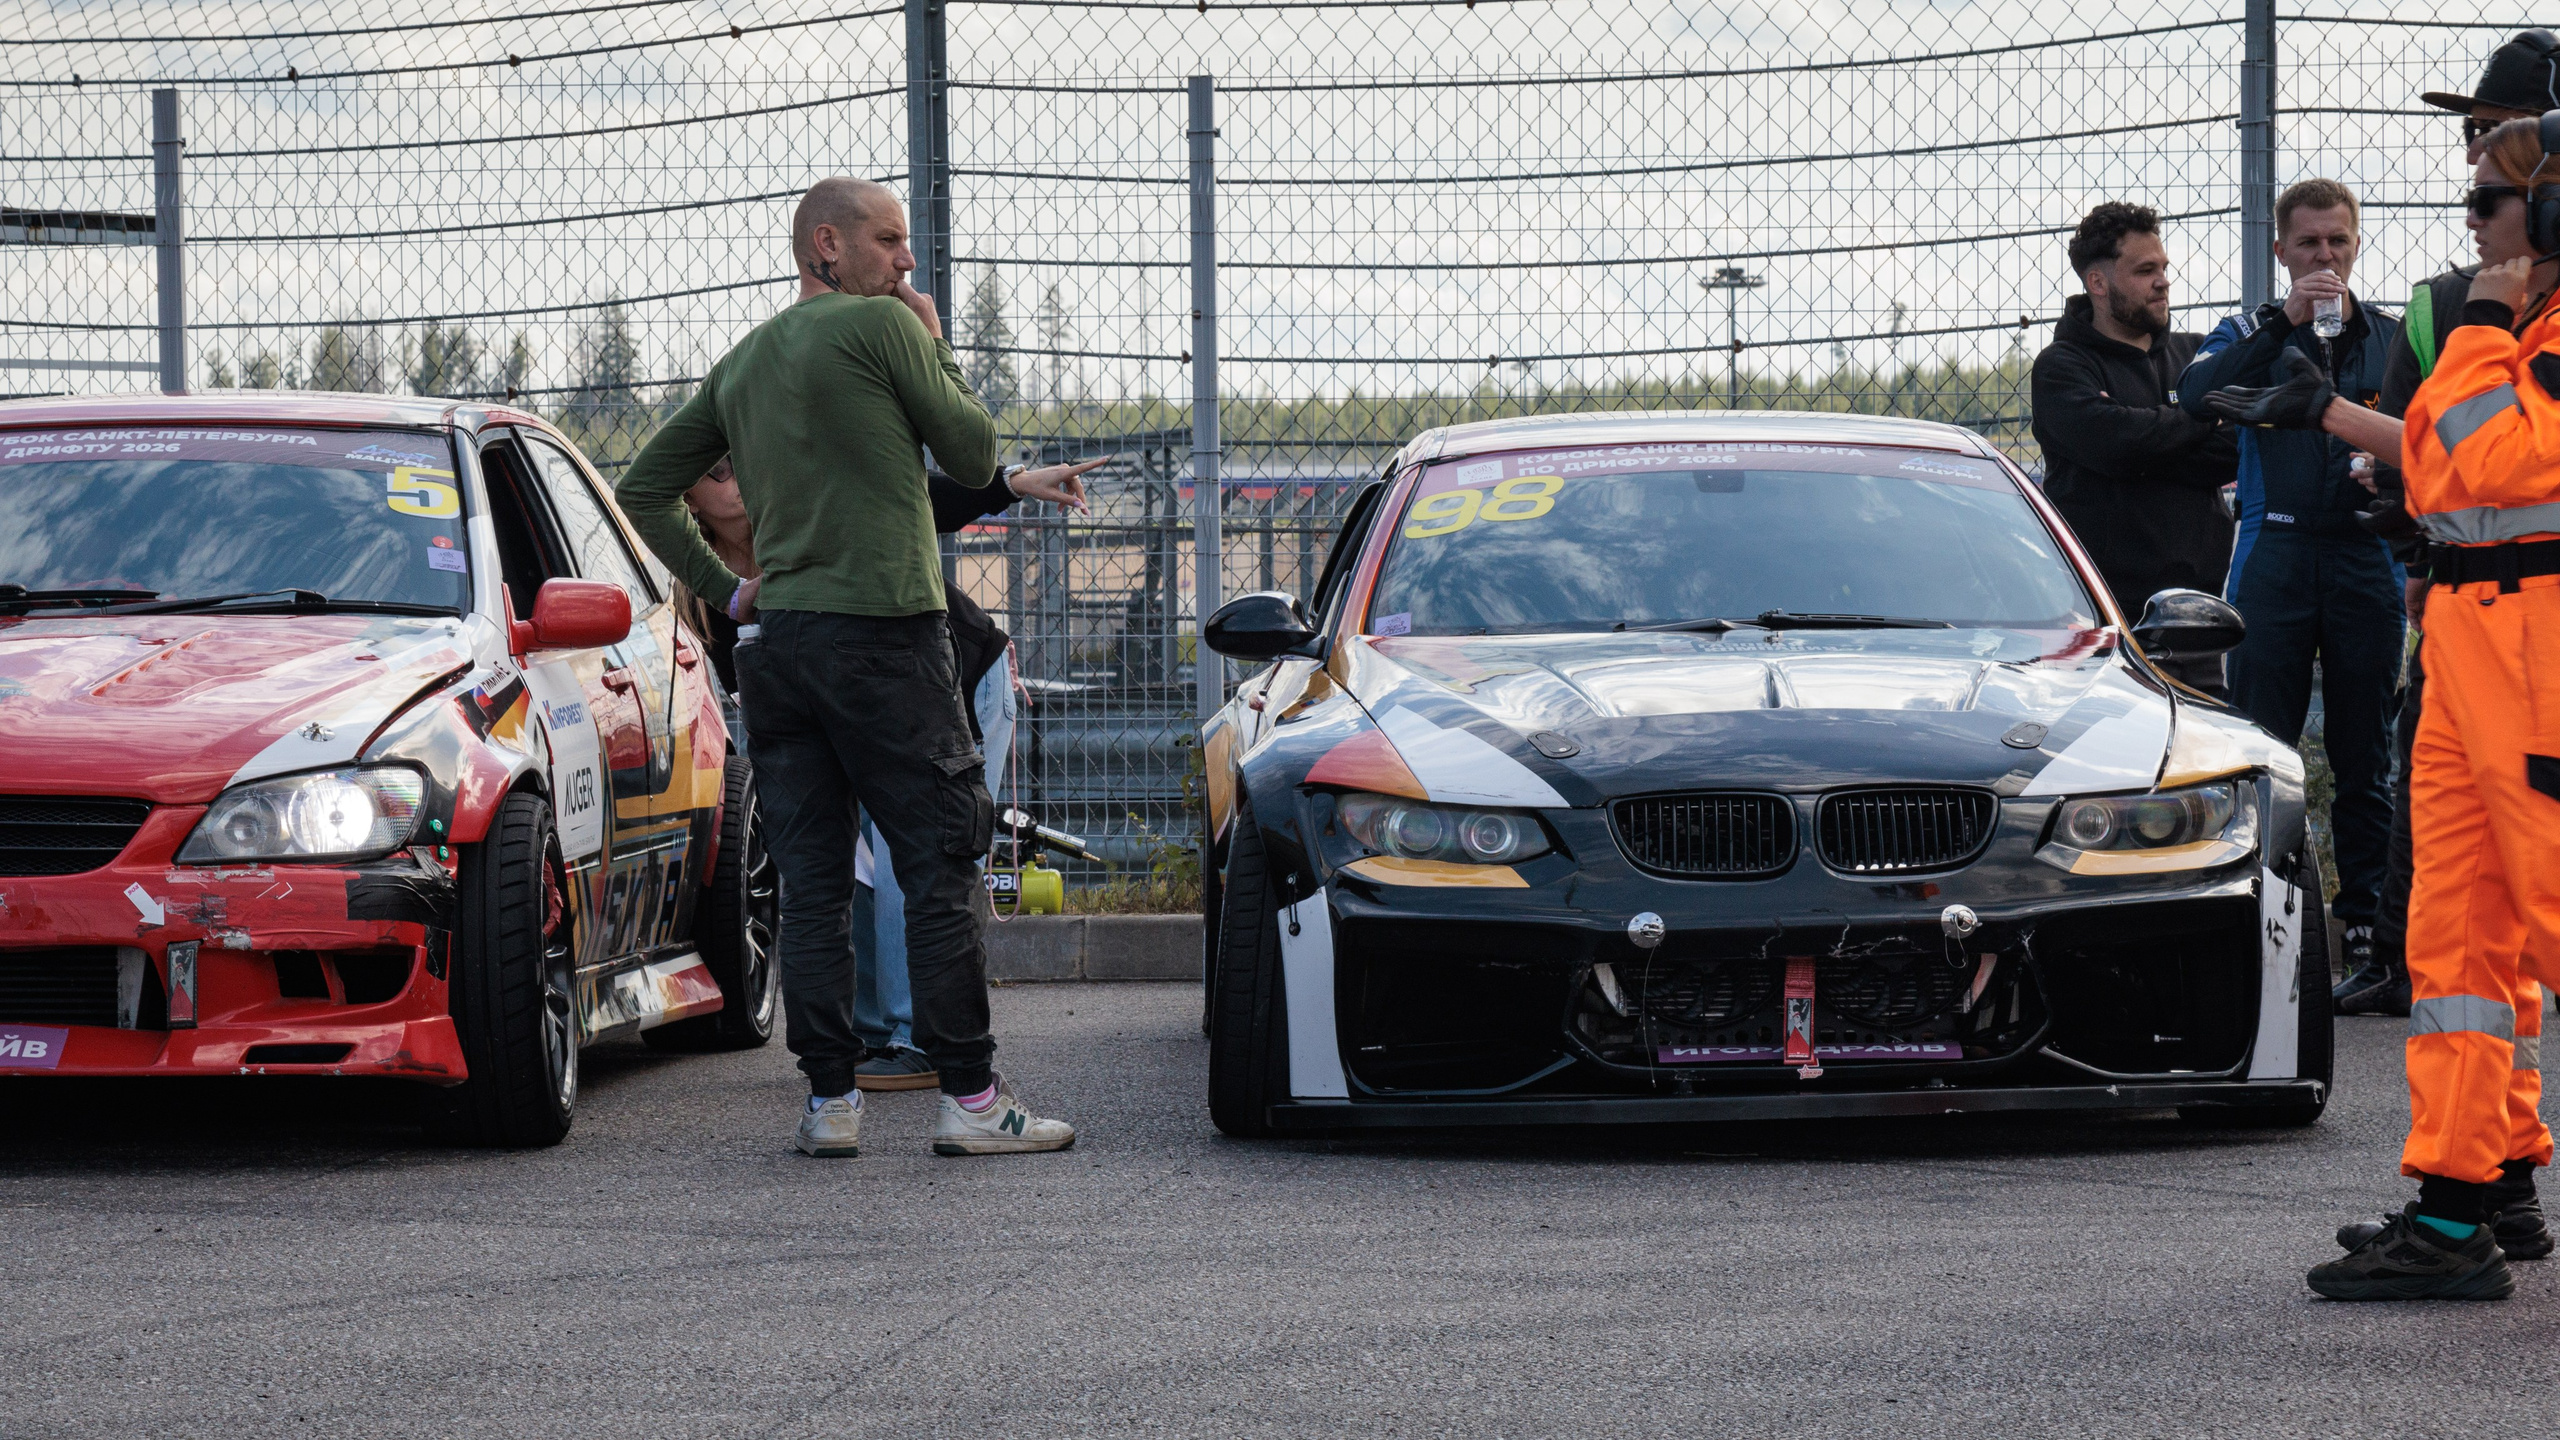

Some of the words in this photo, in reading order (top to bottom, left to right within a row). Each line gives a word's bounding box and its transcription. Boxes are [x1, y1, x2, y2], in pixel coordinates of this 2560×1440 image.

[62, 430, 318, 446] САНКТ-ПЕТЕРБУРГА
[4, 443, 117, 459] ДРИФТУ
[120, 442, 181, 453] 2026
[1517, 446, 1605, 465] КУБОК
[1611, 443, 1866, 458] САНКТ-ПЕТЕРБУРГА
[1518, 464, 1556, 477] ПО
[1562, 455, 1671, 474] ДРИФТУ
[1678, 454, 1738, 465] 2026
[386, 466, 460, 519] 5
[1404, 475, 1565, 539] 98
[2267, 511, 2294, 523] sparco
[825, 1107, 849, 1115] balance
